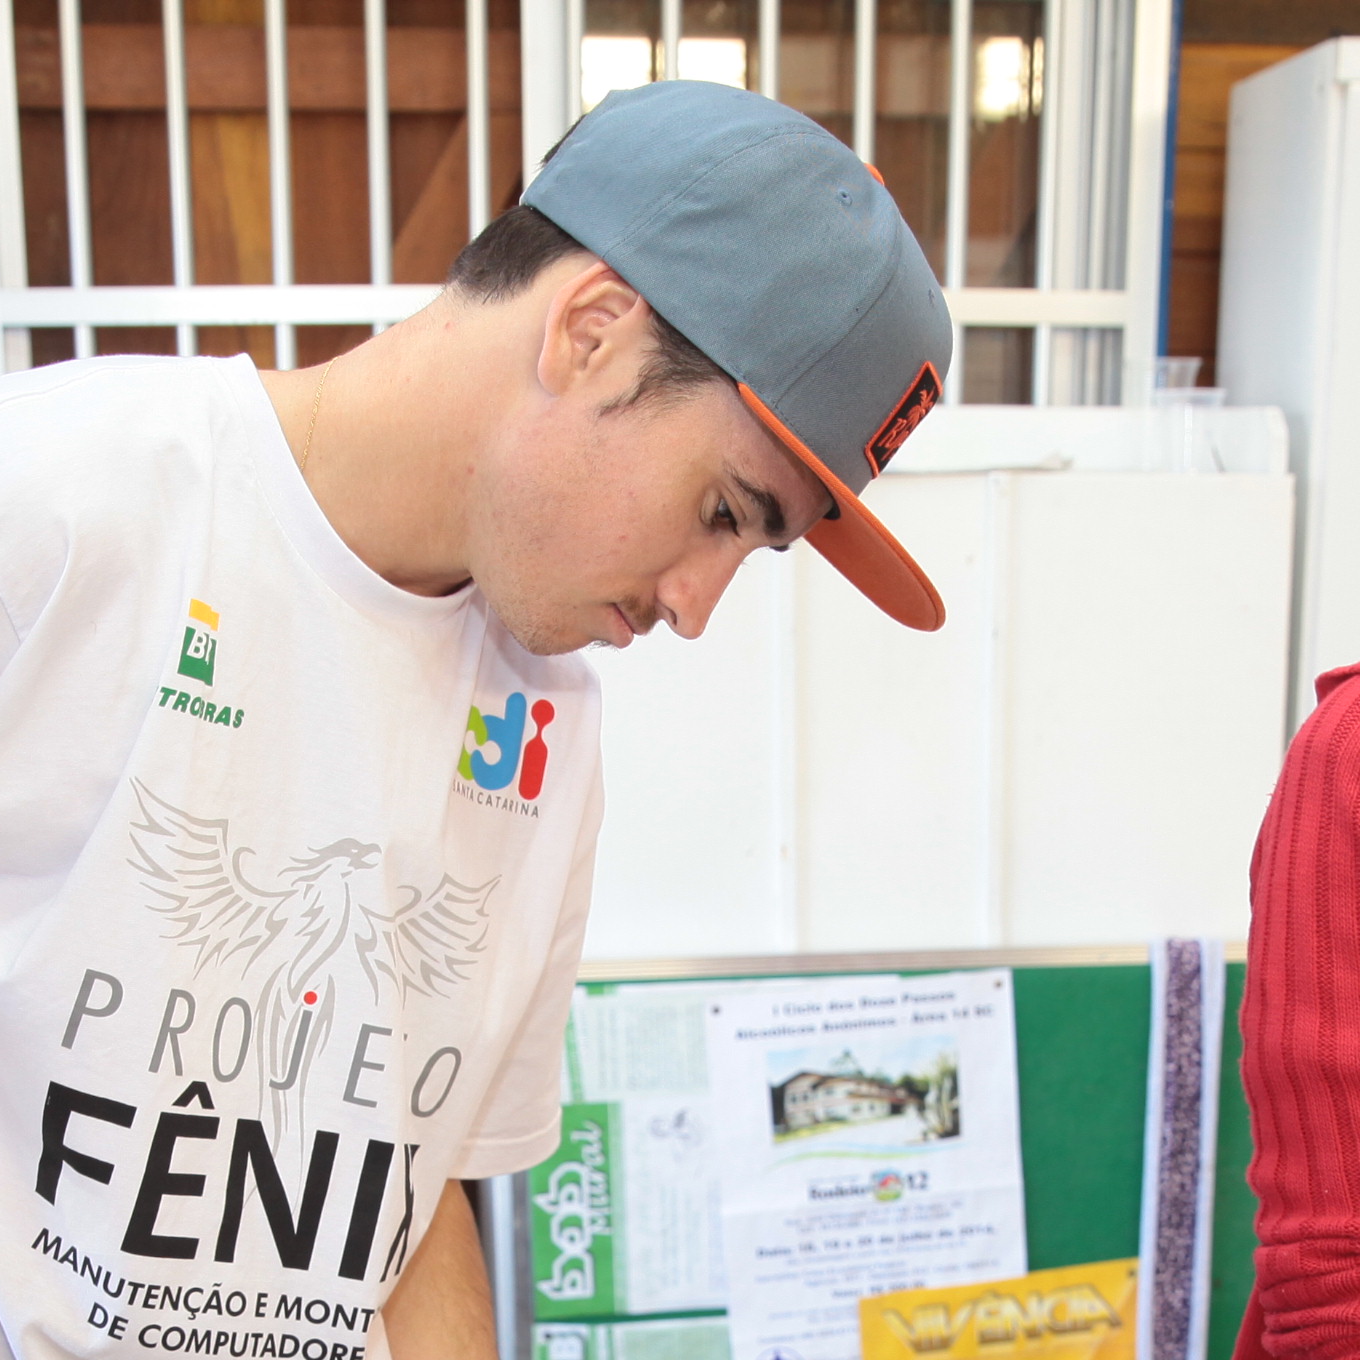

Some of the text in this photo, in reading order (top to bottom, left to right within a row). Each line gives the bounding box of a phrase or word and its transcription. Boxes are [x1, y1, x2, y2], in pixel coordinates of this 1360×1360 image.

[477, 792, 539, 818] CATARINA
[60, 968, 462, 1118] PROJEO
[31, 1227, 379, 1334] MANUTENÇÃO E MONT
[87, 1302, 129, 1341] DE
